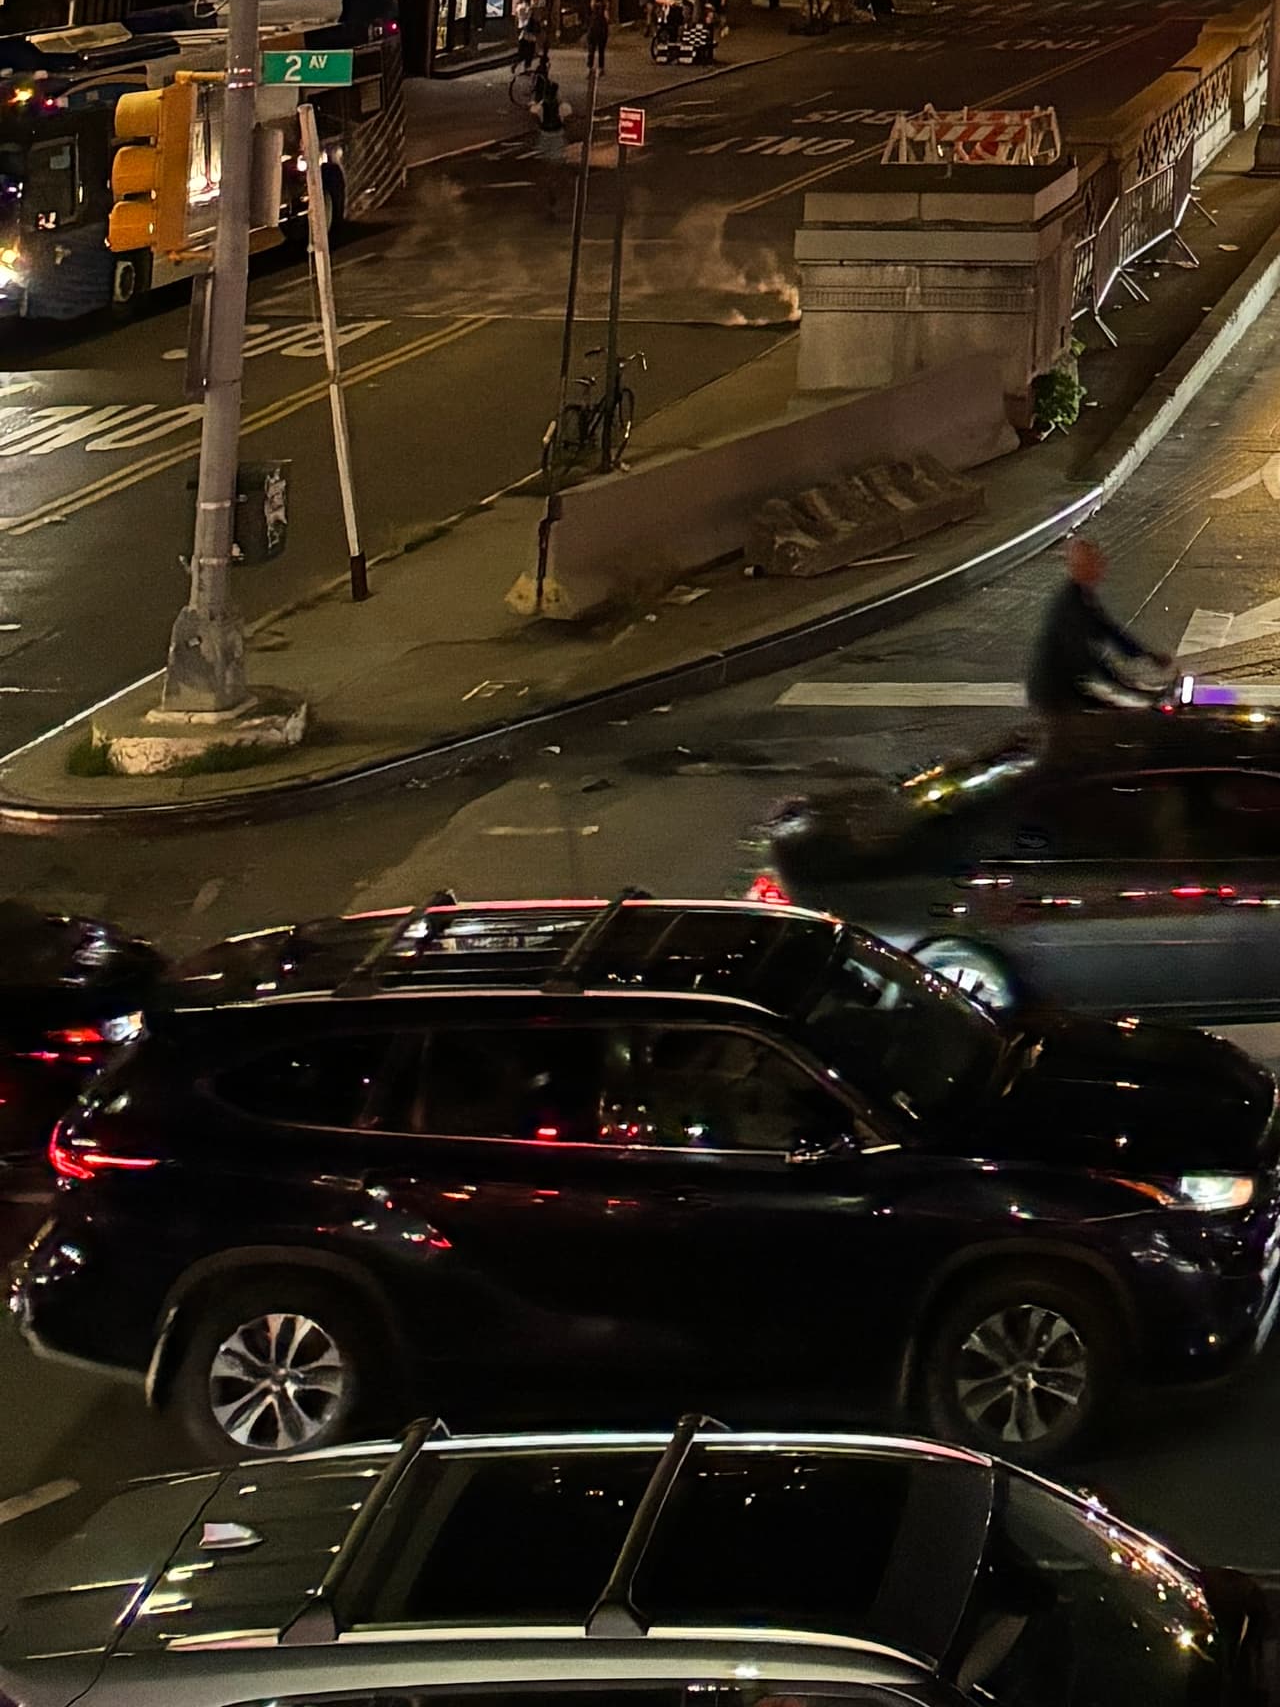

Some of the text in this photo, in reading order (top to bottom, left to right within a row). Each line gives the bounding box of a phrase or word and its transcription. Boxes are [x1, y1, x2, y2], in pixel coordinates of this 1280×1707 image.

[284, 55, 328, 82] 2 AV
[688, 137, 856, 155] ONLY
